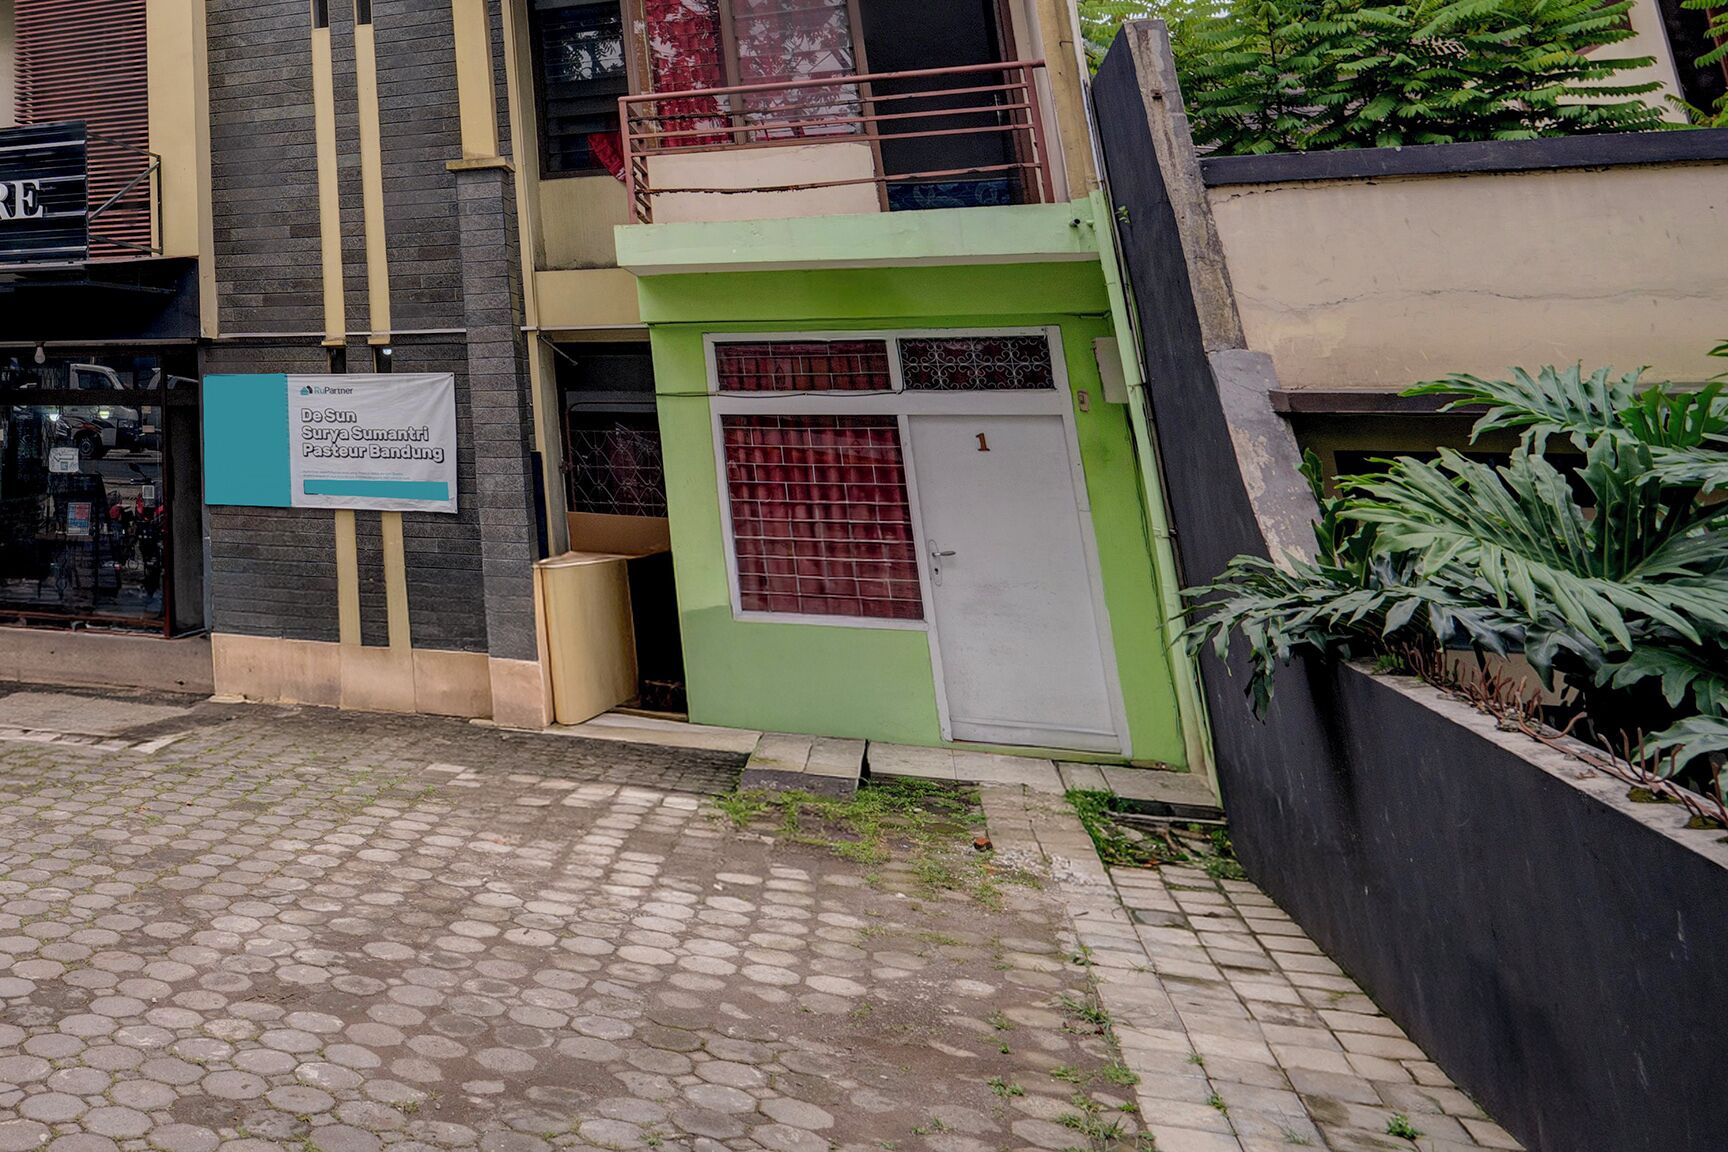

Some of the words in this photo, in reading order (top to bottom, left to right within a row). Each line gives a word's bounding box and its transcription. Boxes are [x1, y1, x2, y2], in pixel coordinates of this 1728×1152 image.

[301, 408, 322, 422] De
[324, 408, 357, 422] Sun
[302, 425, 349, 444] Surya
[351, 426, 429, 442] Sumantri
[976, 432, 991, 452] 1
[303, 443, 367, 458] Pasteur
[369, 444, 445, 463] Bandung
